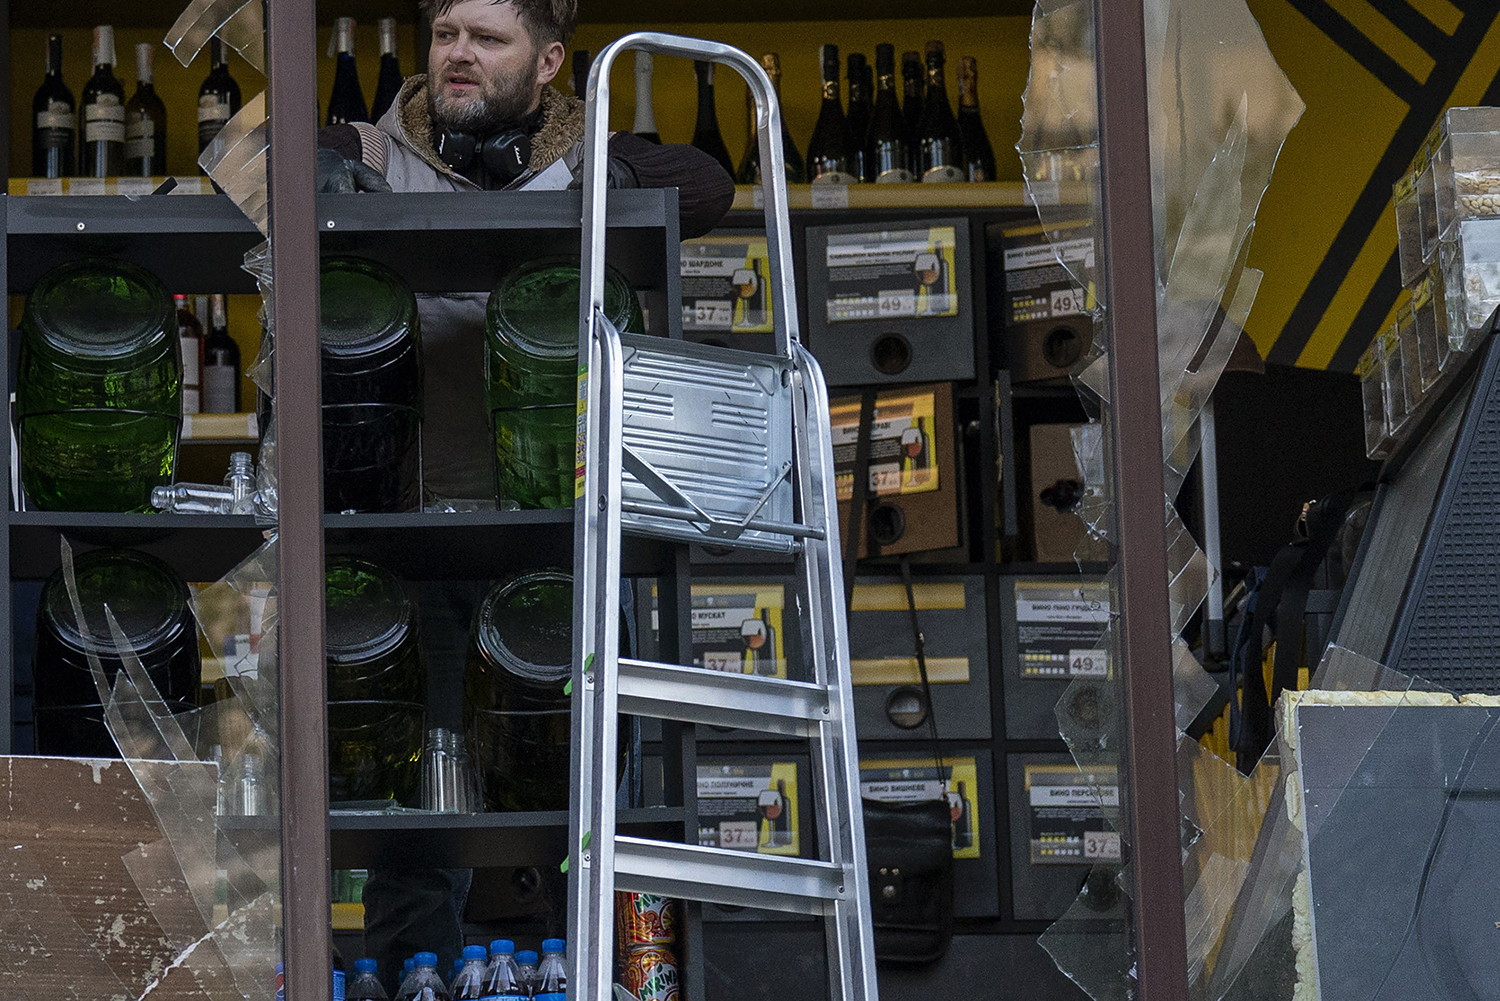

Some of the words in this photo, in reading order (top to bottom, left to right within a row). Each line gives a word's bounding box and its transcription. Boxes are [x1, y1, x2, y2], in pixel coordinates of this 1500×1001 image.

[881, 299, 900, 311] 49
[1053, 297, 1071, 311] 49
[696, 306, 717, 320] 37
[871, 470, 889, 488] 37
[697, 611, 726, 620] МУСКАТ
[1072, 657, 1094, 671] 49
[890, 783, 926, 792] ВИШНЕВЕ
[1049, 789, 1070, 797] ВИНО
[723, 828, 743, 843] 37
[1087, 839, 1107, 854] 37
